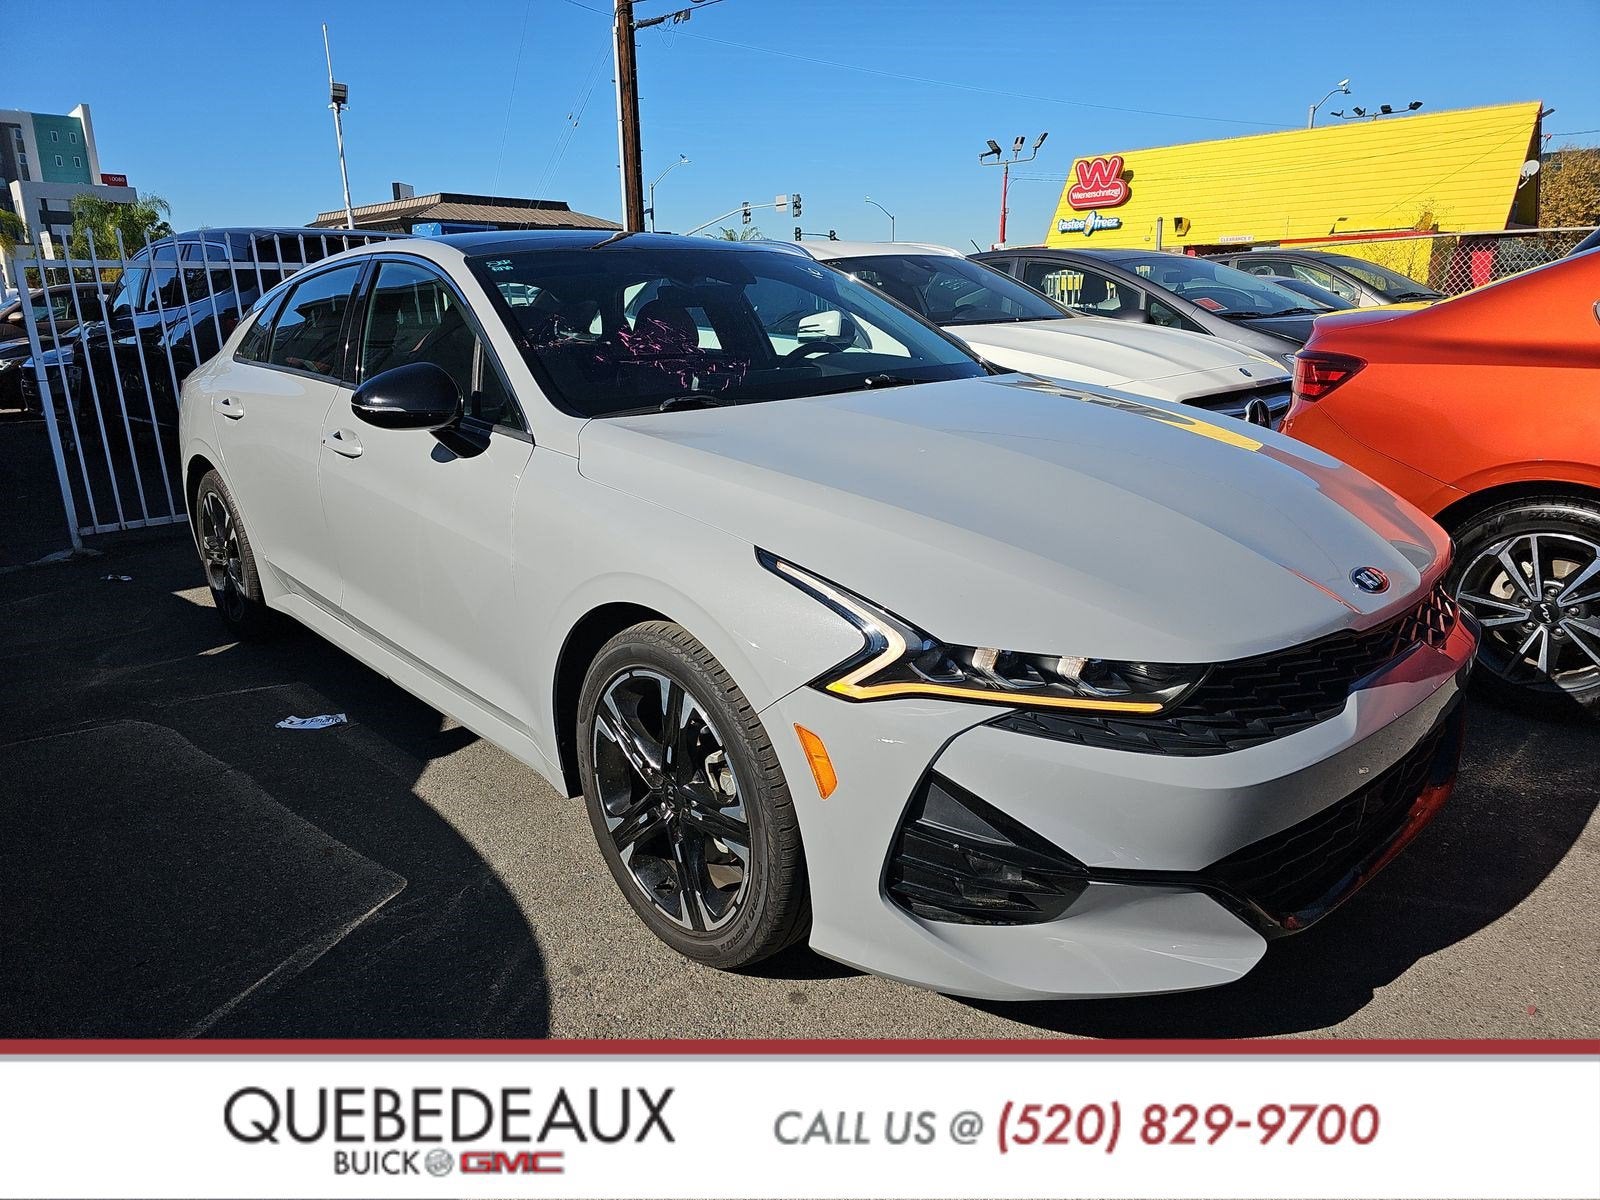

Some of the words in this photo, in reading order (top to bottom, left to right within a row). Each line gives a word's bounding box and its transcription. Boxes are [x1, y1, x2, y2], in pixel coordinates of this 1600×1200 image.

[1071, 188, 1121, 200] Wienerschnitzel
[1058, 219, 1085, 230] tastee
[1094, 215, 1119, 228] freez
